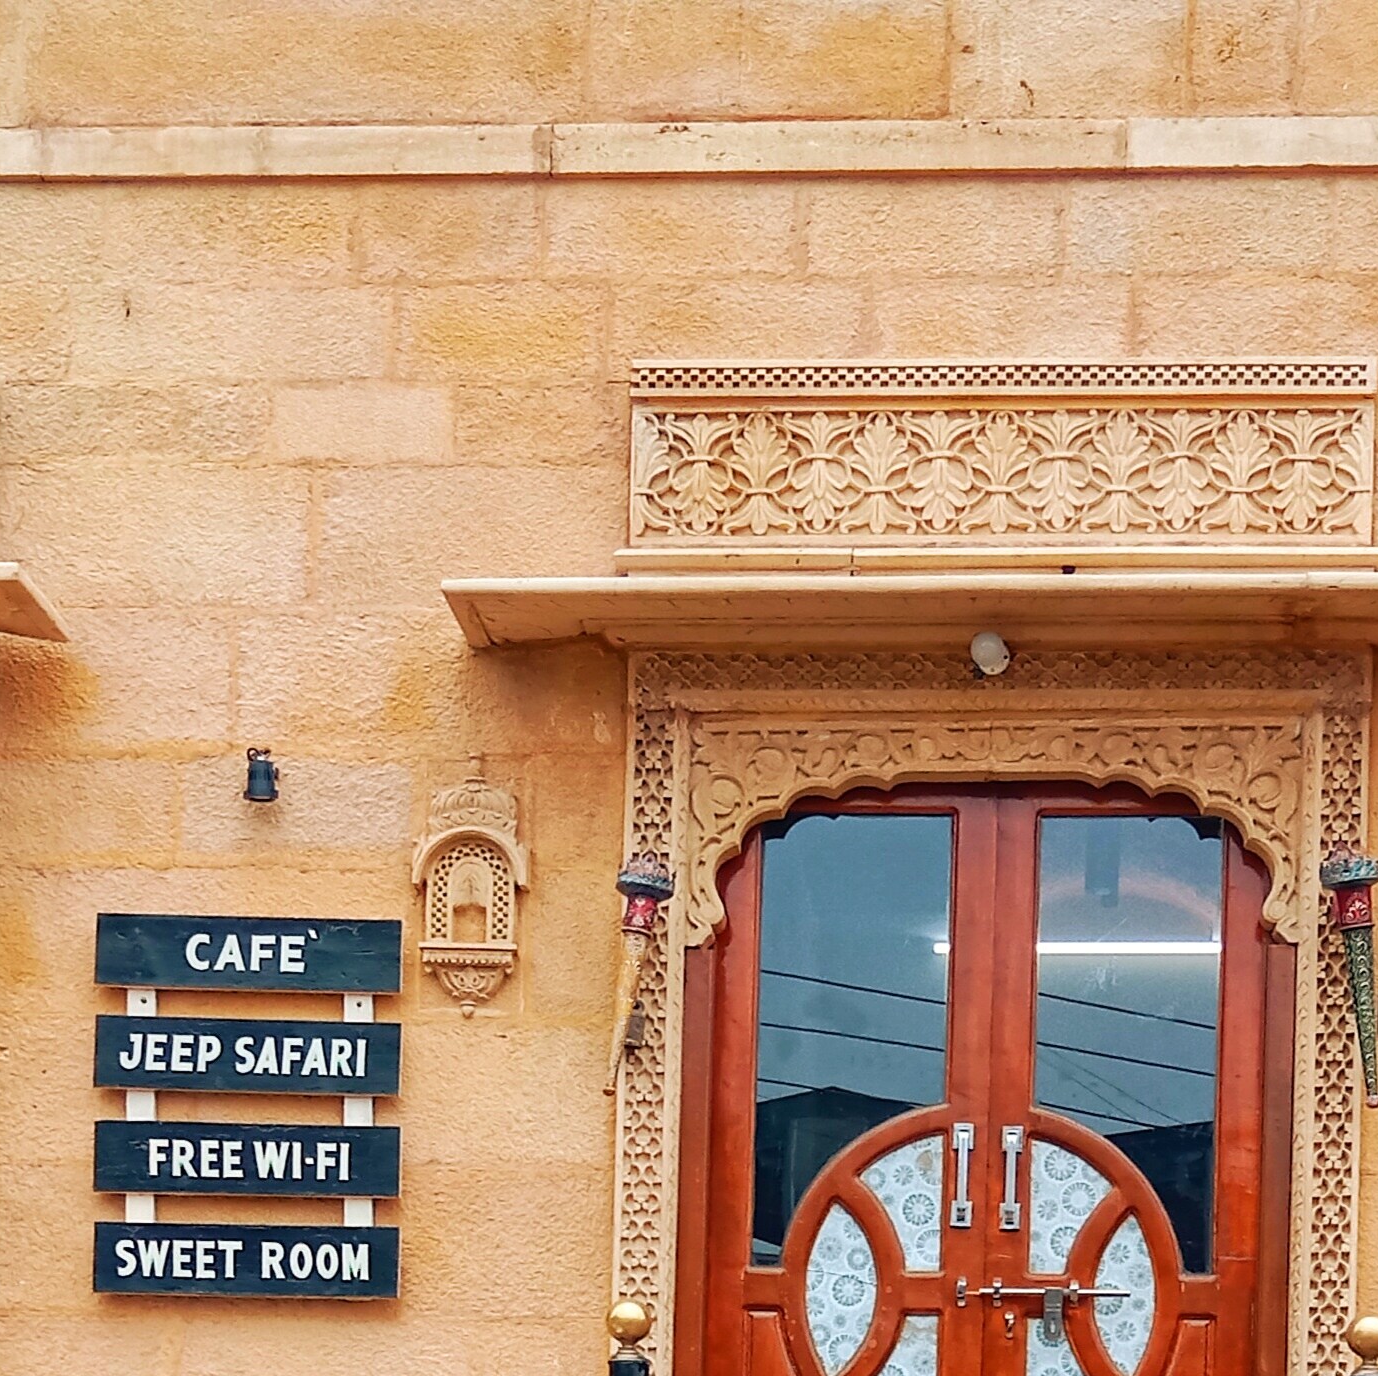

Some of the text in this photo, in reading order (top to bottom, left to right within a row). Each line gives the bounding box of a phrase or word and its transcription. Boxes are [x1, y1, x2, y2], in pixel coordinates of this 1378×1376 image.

[119, 1033, 367, 1077] JEEP SAFARI
[148, 1138, 350, 1181] FREE WI-FI
[115, 1239, 370, 1281] SWEET ROOM
